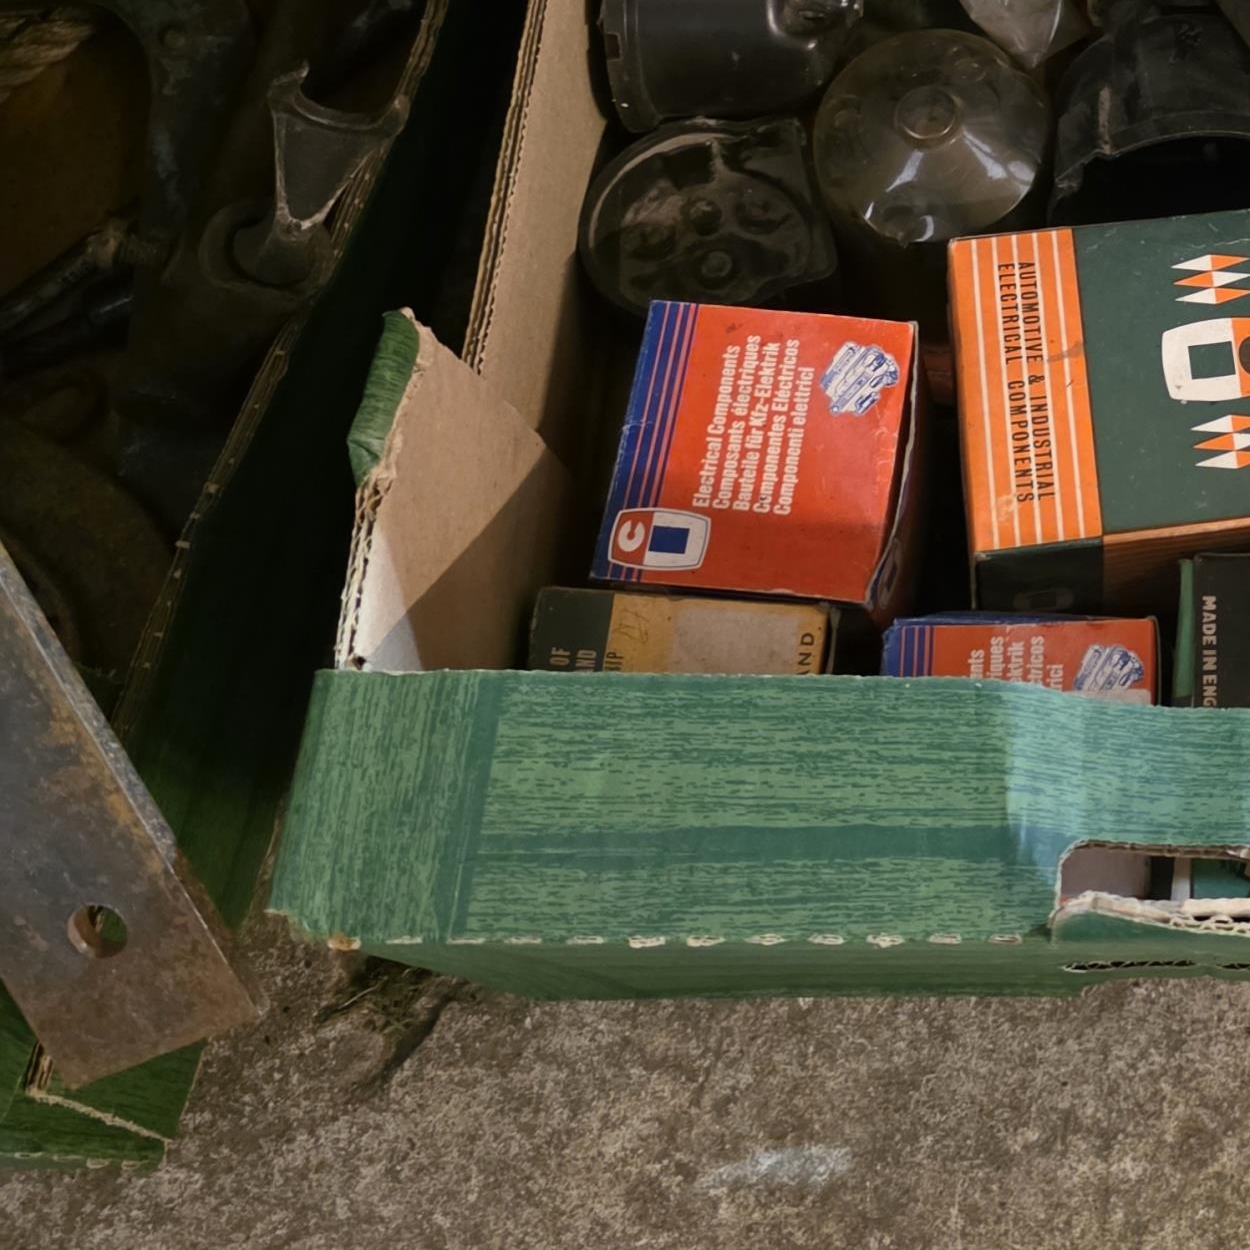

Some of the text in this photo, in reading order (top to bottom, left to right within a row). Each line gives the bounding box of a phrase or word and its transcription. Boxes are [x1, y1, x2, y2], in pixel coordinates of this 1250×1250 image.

[692, 345, 740, 507] Electrical Components
[712, 335, 761, 509] Composants électriques
[732, 342, 781, 511] Bauteile für Kfz-Elektrik
[752, 339, 800, 513] Componentes Eléctricos
[773, 367, 815, 516] Componenti elettrici
[998, 263, 1034, 502] ELECTRICAL COMPONENTS
[1018, 261, 1055, 501] AUTOMOTIVE & INDUSTRIAL
[551, 646, 571, 666] OF
[575, 649, 598, 672] ND
[796, 632, 815, 675] ND
[1201, 595, 1218, 646] MADE
[1202, 650, 1218, 671] IN
